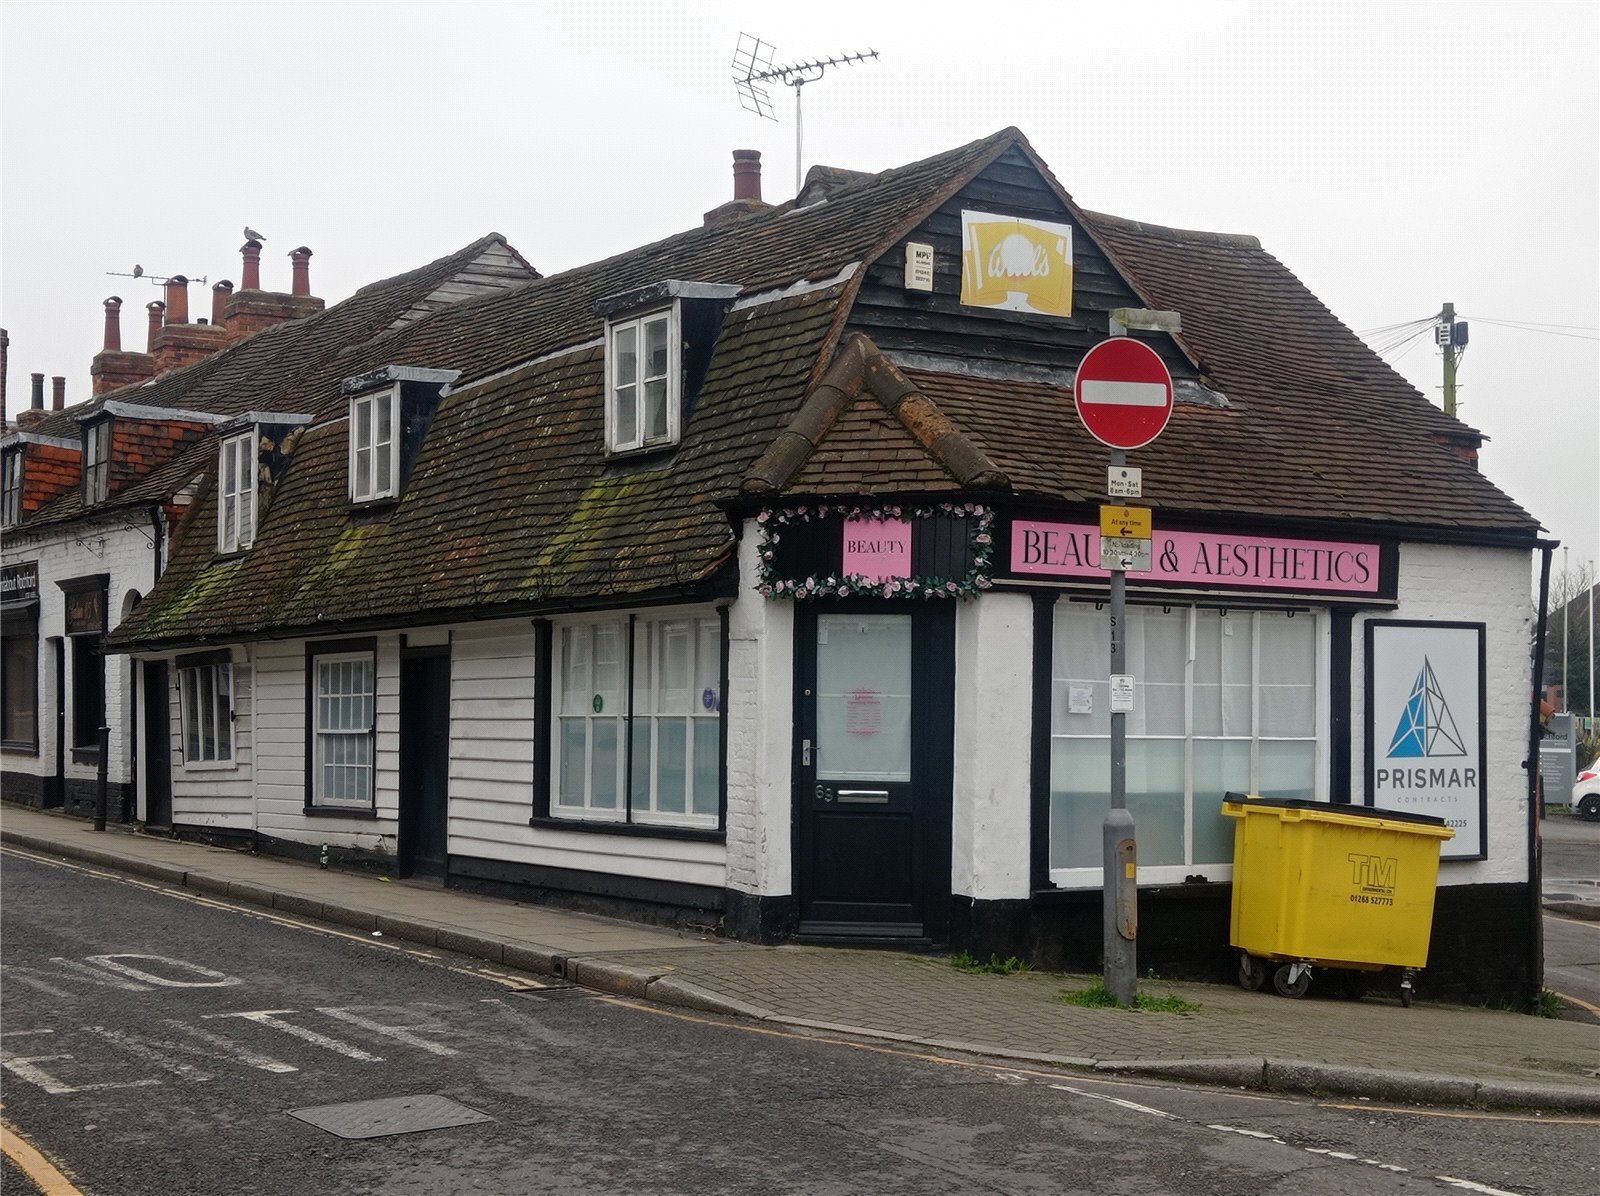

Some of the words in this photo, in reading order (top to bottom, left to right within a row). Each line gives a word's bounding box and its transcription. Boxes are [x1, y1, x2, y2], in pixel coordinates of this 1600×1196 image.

[1111, 518, 1118, 526] At
[1129, 519, 1142, 527] time
[847, 540, 907, 554] BEAUTY
[1022, 528, 1101, 569] BEAU
[1159, 538, 1181, 574] &
[1190, 541, 1372, 585] AESTHETICS
[1376, 767, 1477, 789] PRISMAR
[1397, 796, 1459, 804] CONTRACTS
[1445, 819, 1468, 828] 42225
[1350, 894, 1370, 904] 01268
[1370, 896, 1394, 907] 527773
